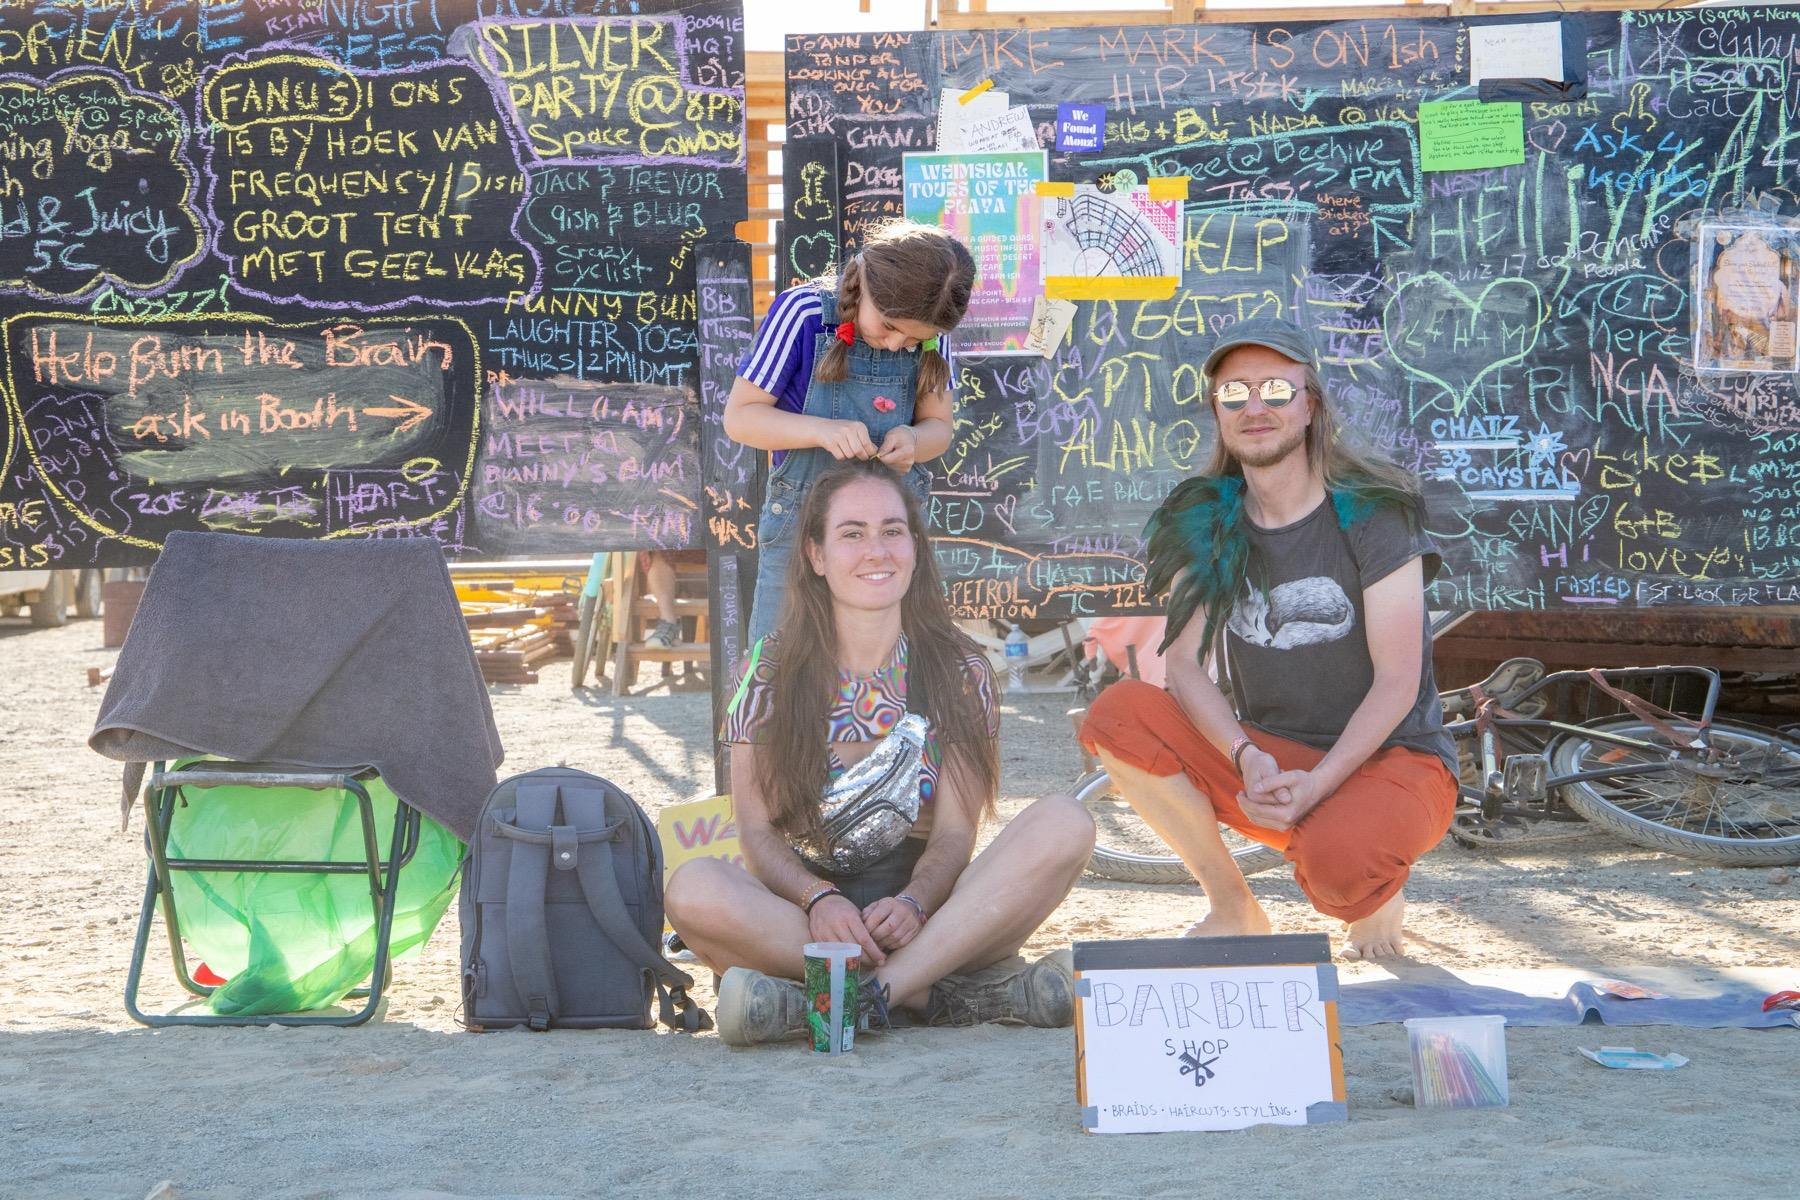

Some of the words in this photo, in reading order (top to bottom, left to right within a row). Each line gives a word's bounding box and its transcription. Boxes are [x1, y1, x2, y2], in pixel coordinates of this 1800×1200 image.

[478, 22, 681, 79] SILVER
[1100, 27, 1226, 67] MARK
[1252, 28, 1296, 71] IS
[1312, 25, 1369, 68] ON
[509, 70, 622, 119] PARTY
[857, 94, 901, 114] YOU
[1062, 122, 1097, 134] Found
[1072, 110, 1089, 121] We
[328, 129, 418, 159] HOEK
[433, 119, 497, 151] VAN
[527, 125, 632, 158] Space
[920, 162, 1029, 181] WHIMSICAL
[909, 180, 969, 199] TOURS
[975, 180, 1000, 196] OF
[944, 197, 1006, 215] PLAYA
[233, 209, 358, 243] GROOT
[374, 212, 472, 246] TENT
[242, 246, 326, 282] MET
[344, 249, 447, 281] GEEL
[454, 247, 525, 283] VLAG
[504, 291, 623, 322] FUNNY
[488, 318, 622, 350] LAUGHTER
[31, 328, 117, 385] Help
[1430, 415, 1522, 439] CHATZ
[1461, 466, 1582, 491] CRYSTAL
[1619, 538, 1691, 577] love
[952, 576, 1030, 607] PETROL
[1094, 980, 1325, 1032] BARBER
[1164, 1038, 1229, 1057] SHOP
